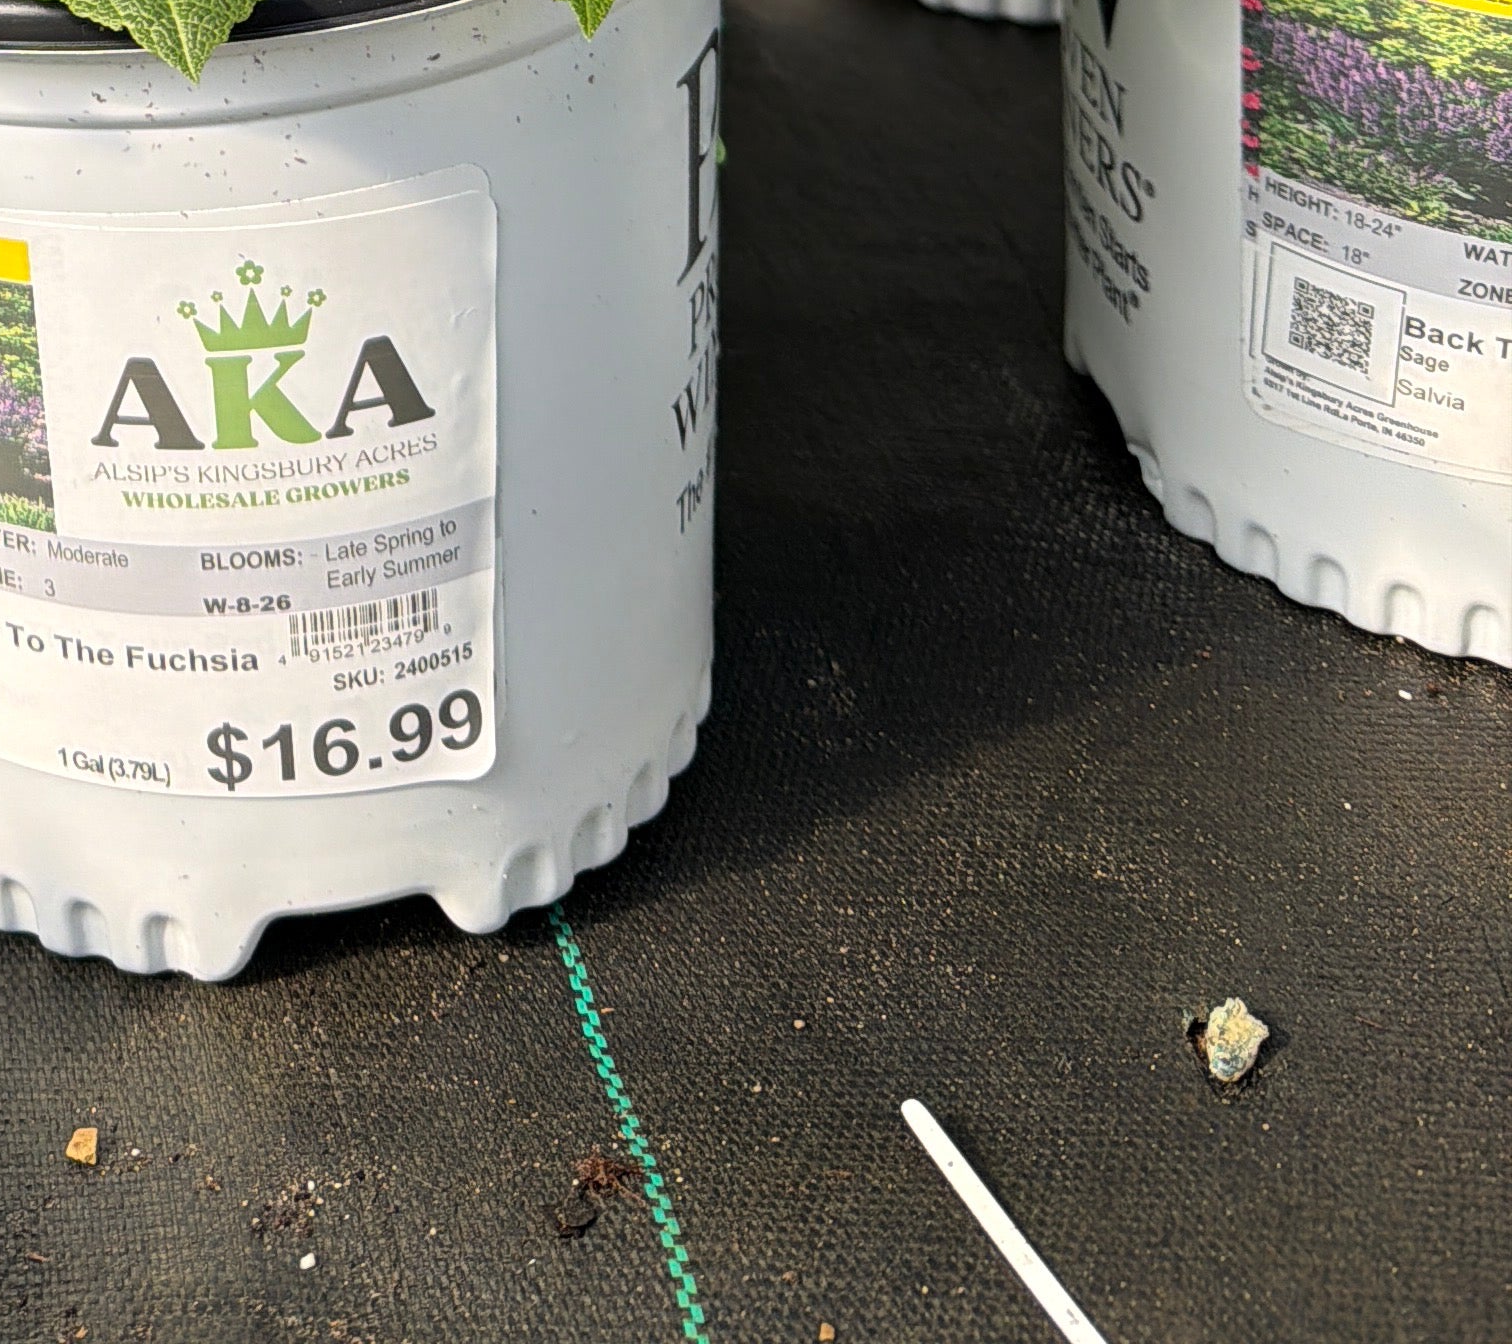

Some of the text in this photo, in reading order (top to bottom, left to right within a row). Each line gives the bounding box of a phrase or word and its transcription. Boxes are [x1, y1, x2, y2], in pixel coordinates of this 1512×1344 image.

[1265, 176, 1338, 221] HEIGHT:
[1344, 209, 1402, 239] 18-24"
[1262, 211, 1329, 253] SPACE:
[1342, 244, 1370, 265] 18"
[1403, 315, 1485, 356] Back
[1399, 345, 1451, 374] Sage
[90, 334, 436, 450] AKA
[1396, 378, 1466, 411] Salvia
[1376, 412, 1440, 439] Greenhouse
[93, 432, 438, 484] ALSIP'S KINGSBURY ACRES
[121, 468, 411, 510] WHOLESALE GROWERS
[47, 538, 130, 568] Moderate
[200, 518, 458, 572] BLOOMS: Late Spring to
[43, 577, 56, 598] 3
[327, 544, 462, 590] Early Summer
[202, 594, 292, 614] W-8-26
[5, 622, 46, 653] To
[53, 633, 115, 668] The
[125, 644, 259, 673] Fuchsia
[277, 654, 287, 666] 4
[309, 644, 366, 663] 91521
[370, 628, 426, 653] 23479
[332, 640, 474, 692] SKU: 2400515
[206, 688, 483, 792] $16.99
[57, 747, 172, 789] 1 Gal (3.79L)
